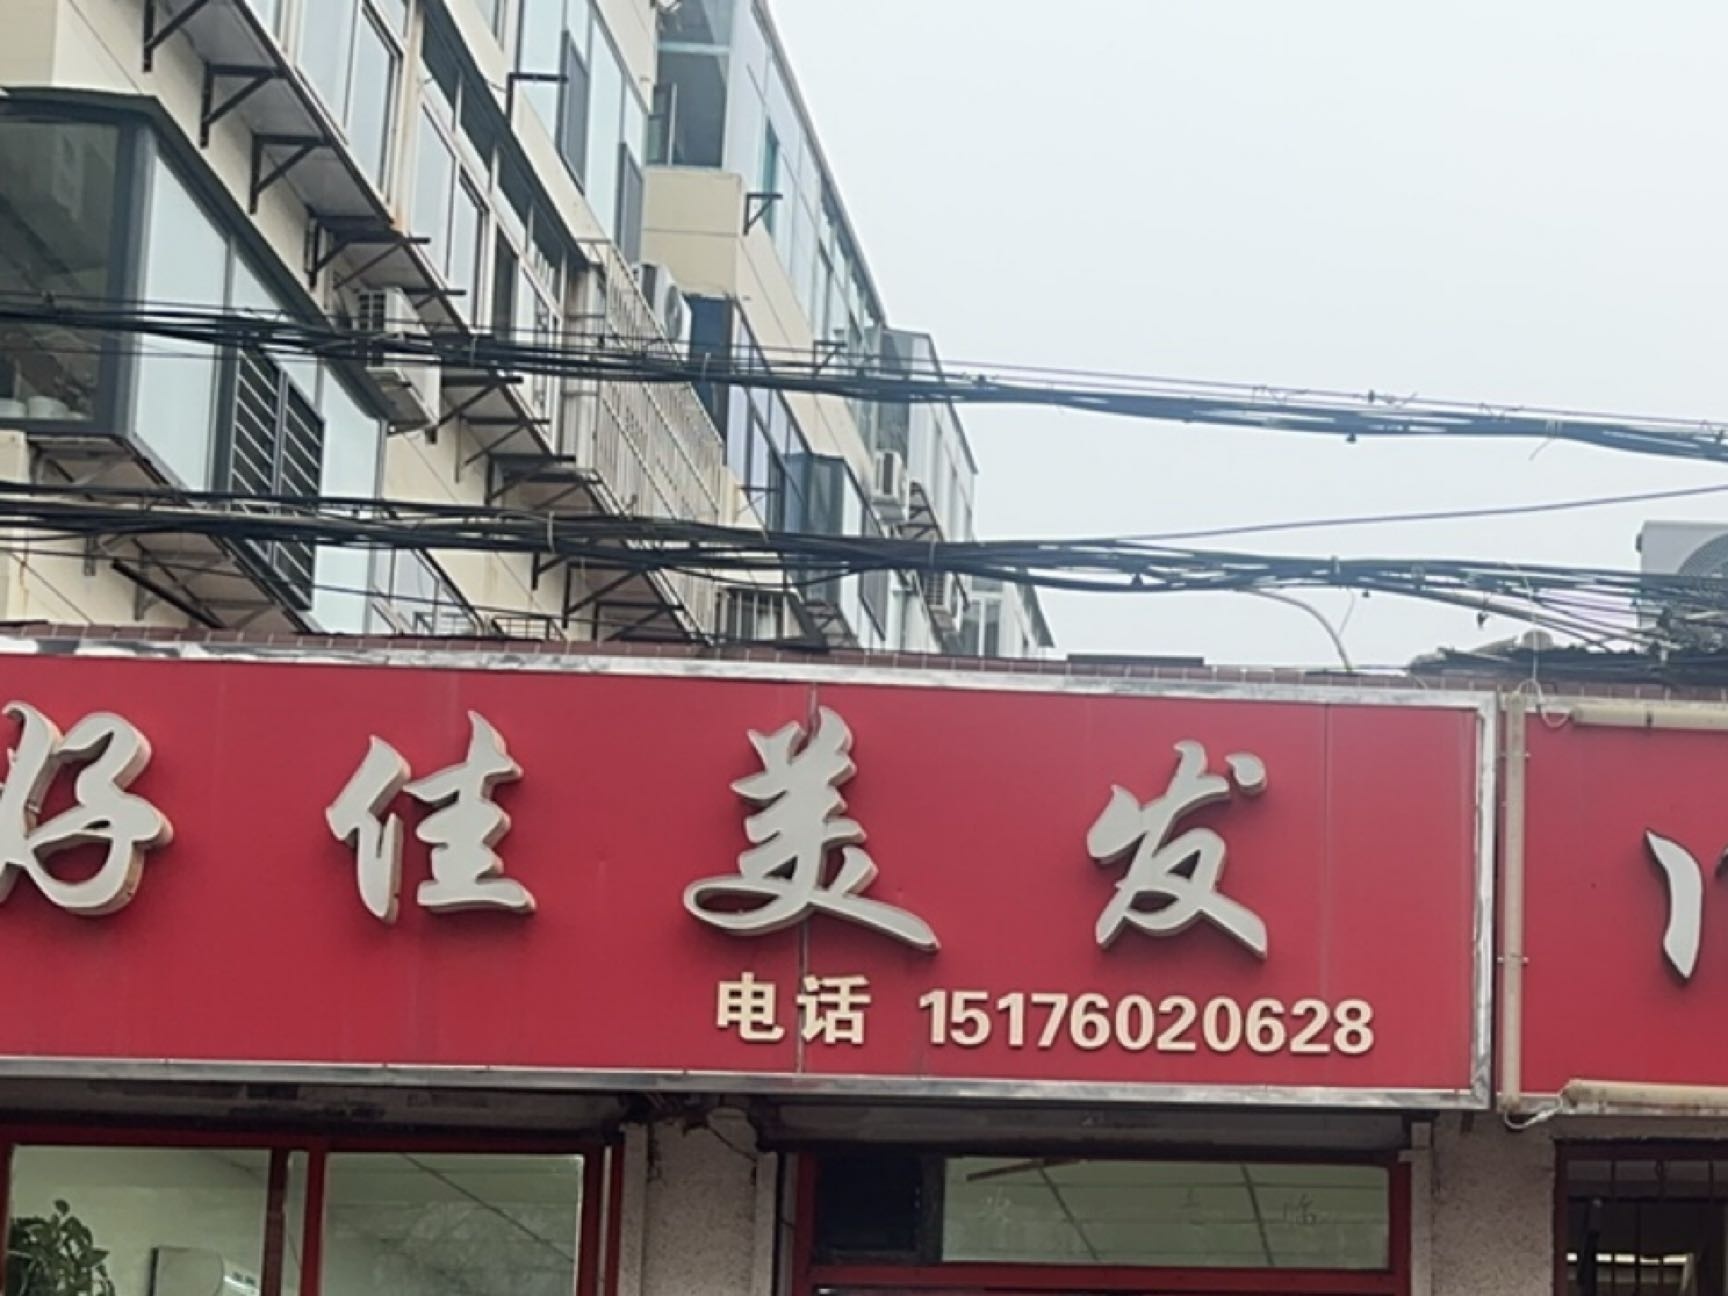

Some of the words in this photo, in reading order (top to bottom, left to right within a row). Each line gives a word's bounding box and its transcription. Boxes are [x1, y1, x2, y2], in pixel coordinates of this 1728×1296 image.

[0, 700, 1268, 960] 好佳美发
[716, 971, 871, 1046] 电话
[918, 989, 1375, 1057] 15176020628
